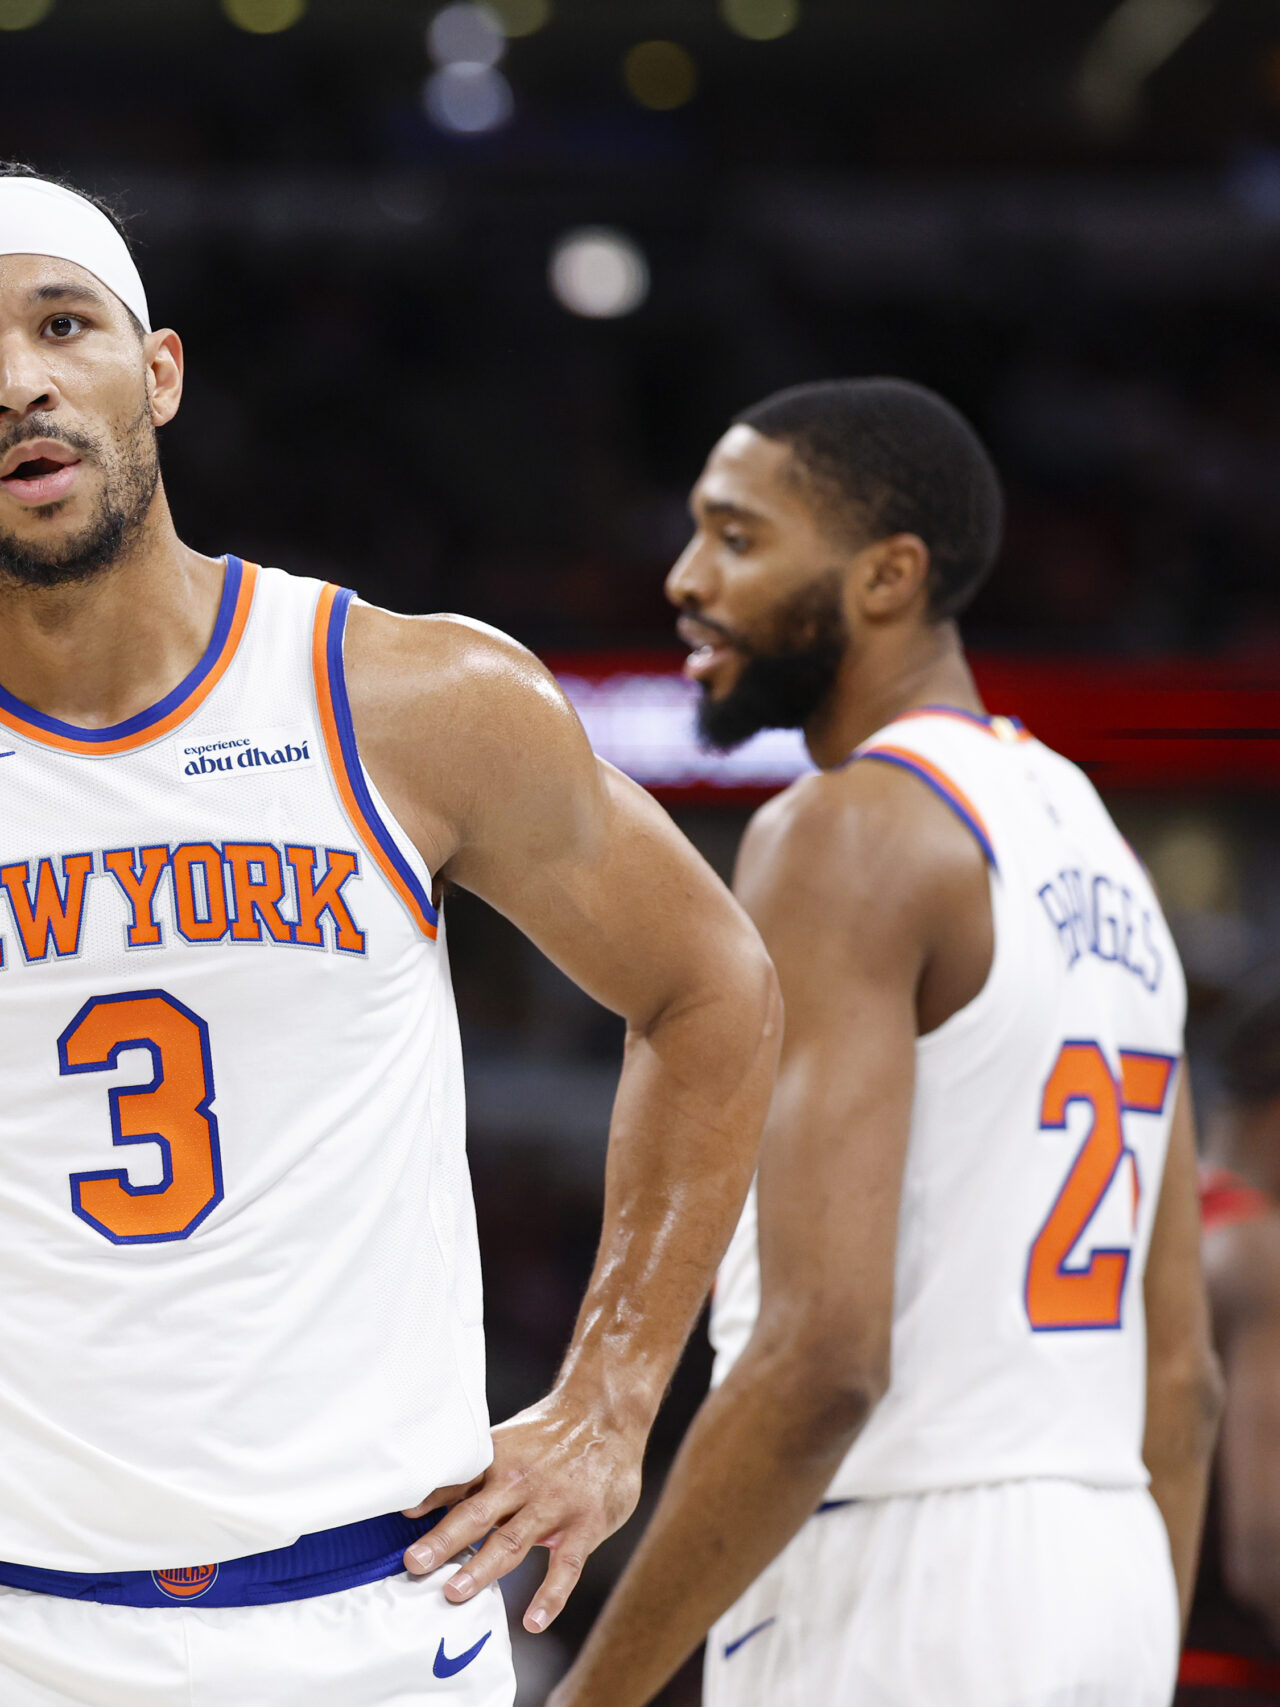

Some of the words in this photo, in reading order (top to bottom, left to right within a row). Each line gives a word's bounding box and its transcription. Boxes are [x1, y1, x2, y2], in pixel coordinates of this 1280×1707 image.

[184, 738, 251, 755] experience
[184, 755, 233, 776] abu
[102, 841, 369, 958] YORK
[57, 989, 224, 1245] 3
